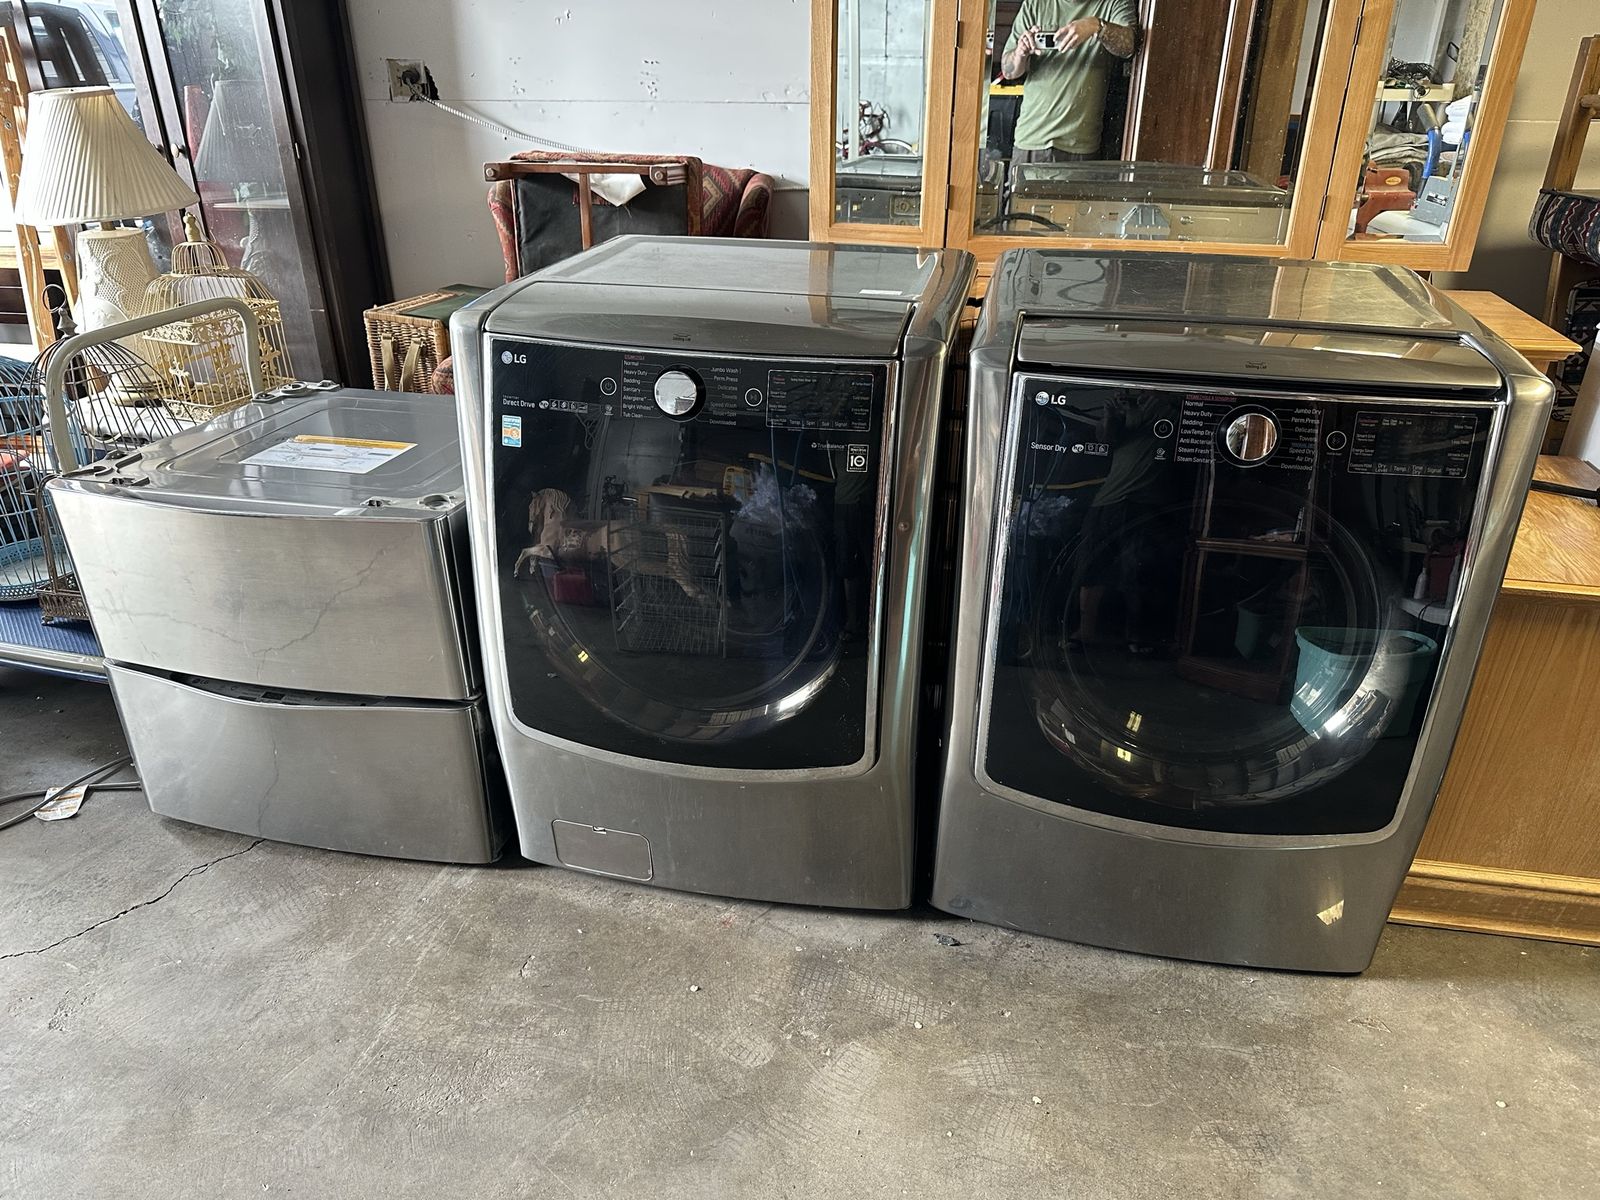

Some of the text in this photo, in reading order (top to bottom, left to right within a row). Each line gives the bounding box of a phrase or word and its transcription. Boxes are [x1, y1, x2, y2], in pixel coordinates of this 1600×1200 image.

[514, 354, 527, 364] LG
[502, 399, 536, 408] Direct Drive
[1050, 394, 1067, 405] LG
[1182, 419, 1204, 427] Bedding
[1031, 441, 1067, 453] Sensor Dry
